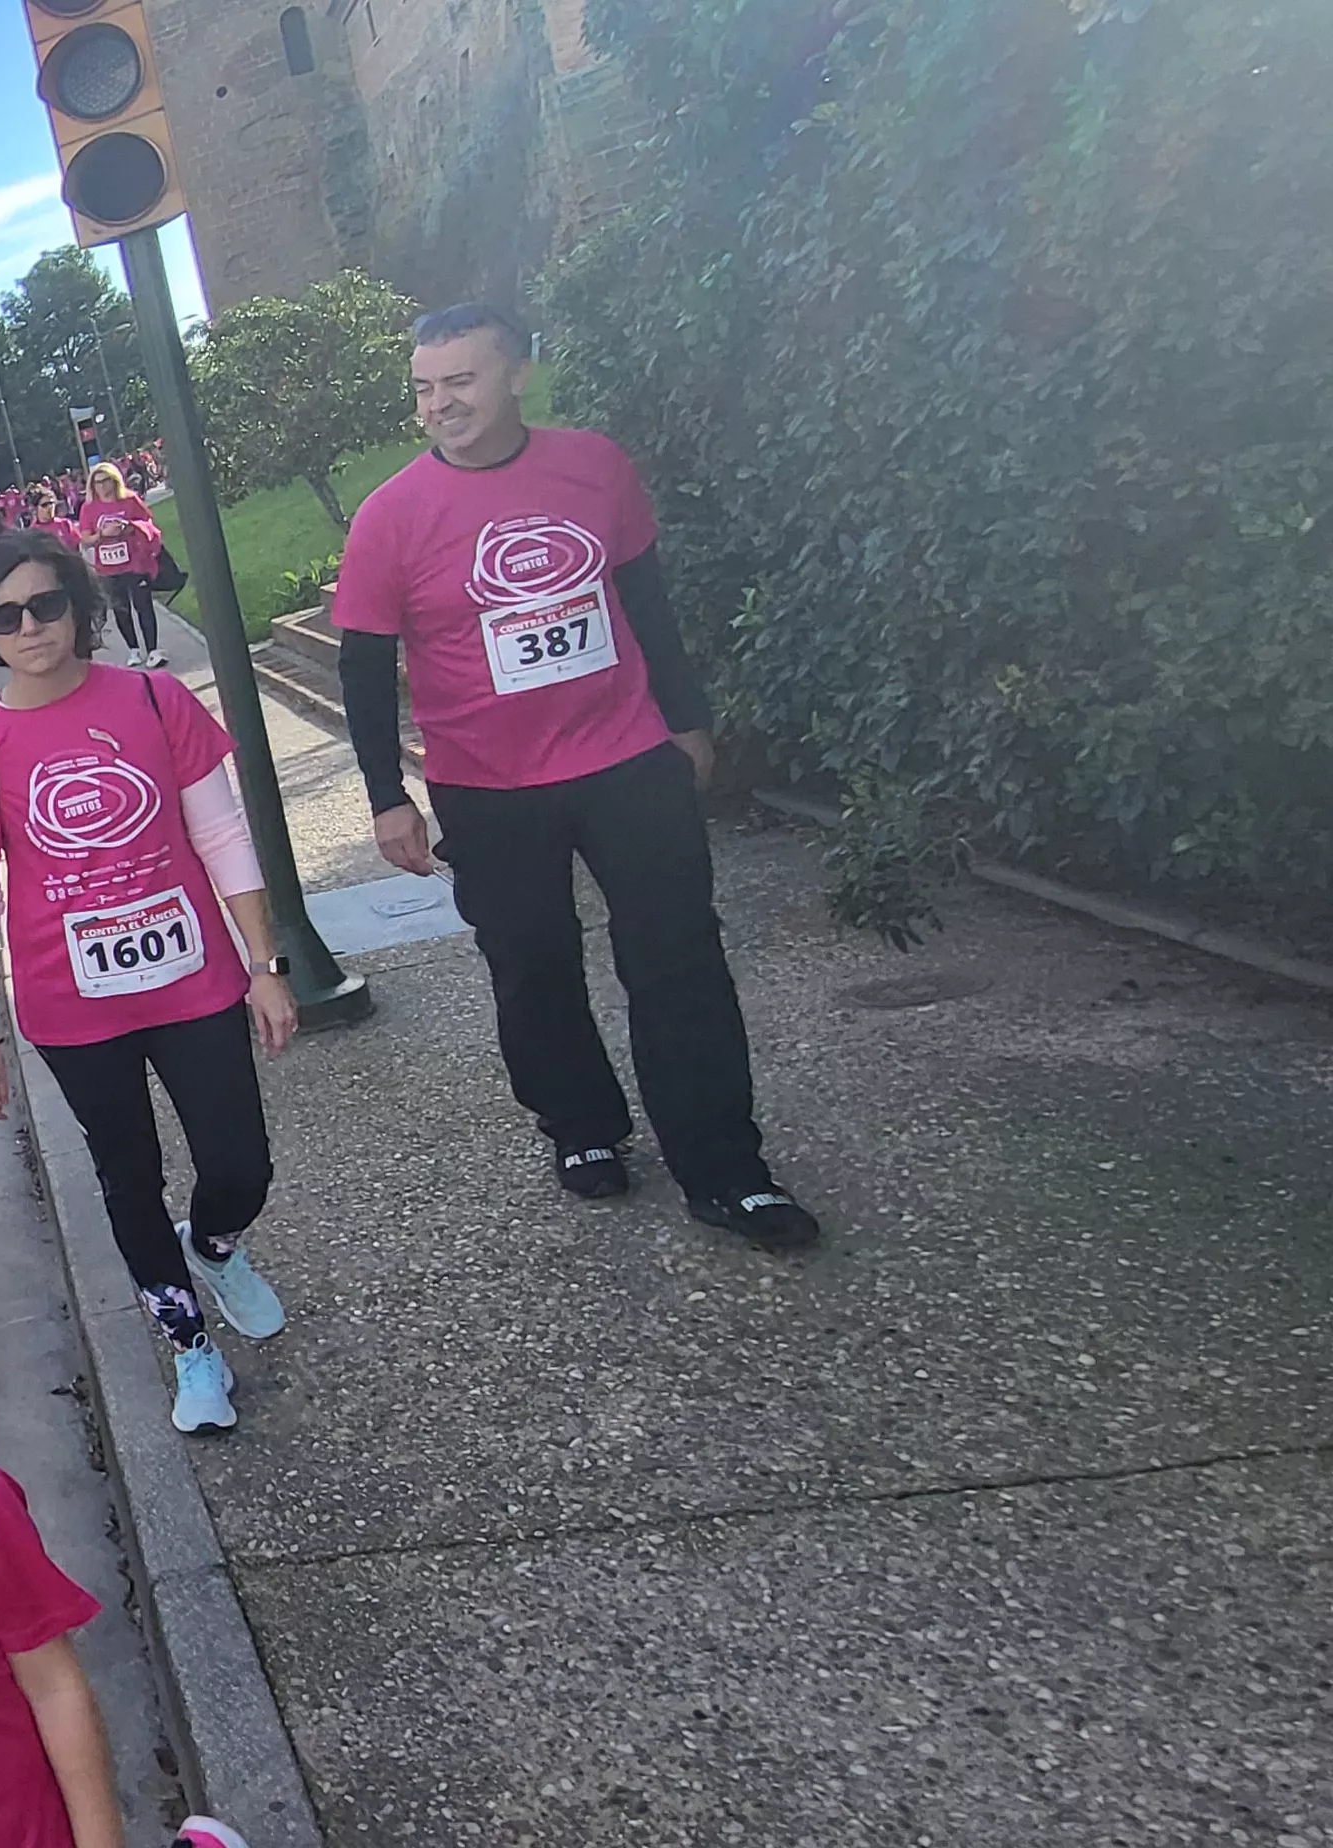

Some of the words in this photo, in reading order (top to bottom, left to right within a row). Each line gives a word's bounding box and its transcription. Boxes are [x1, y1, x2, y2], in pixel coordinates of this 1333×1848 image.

[511, 555, 549, 574] JUNTOS
[499, 617, 546, 634] CONTRA
[516, 617, 589, 665] 387
[64, 799, 103, 819] JUNTOS
[81, 925, 127, 938] CONTRA
[128, 922, 141, 930] EL
[142, 907, 181, 925] CÁNCER
[86, 921, 188, 972] 1601
